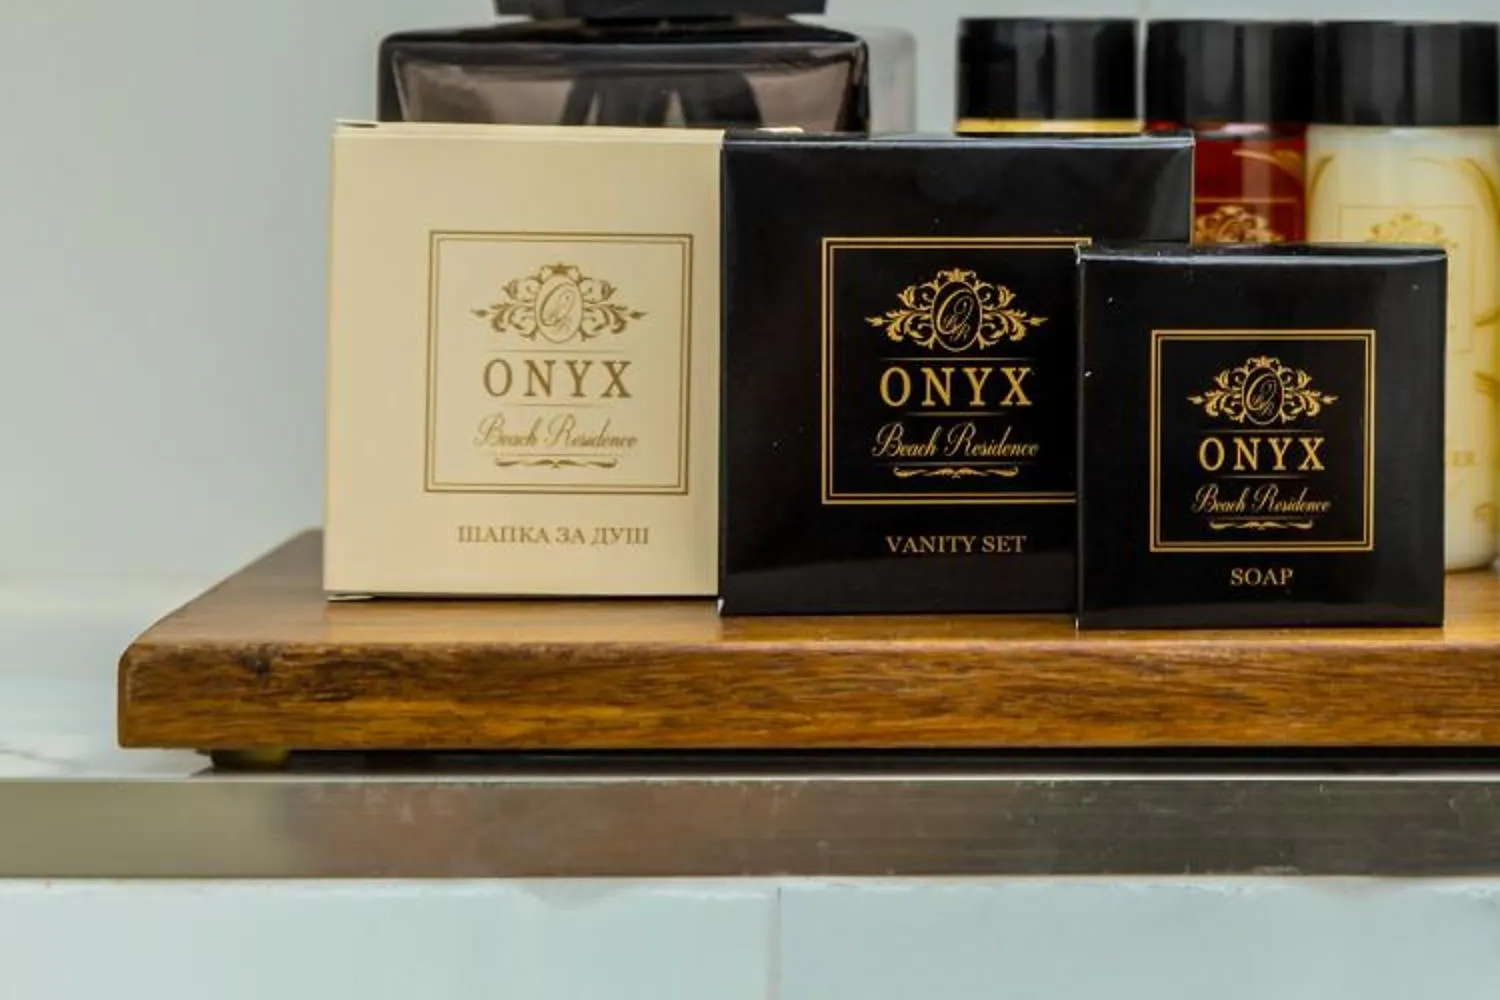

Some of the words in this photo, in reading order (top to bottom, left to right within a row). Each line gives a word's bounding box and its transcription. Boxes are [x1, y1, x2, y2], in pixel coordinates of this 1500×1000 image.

[483, 358, 632, 399] ONYX
[880, 366, 1033, 407] ONYX
[473, 412, 542, 447] Beach
[545, 413, 638, 447] Residence
[872, 422, 942, 457] Beach
[944, 422, 1039, 457] Residence
[1198, 436, 1326, 472] ONYX
[1191, 483, 1249, 513] Beach
[1252, 483, 1331, 513] Residence
[458, 525, 550, 544] ШАПКА
[555, 526, 585, 545] ЗА
[591, 526, 649, 545] ДУШ
[885, 535, 976, 553] VANITY
[982, 535, 1028, 553] SET
[1230, 568, 1294, 586] SOAP
